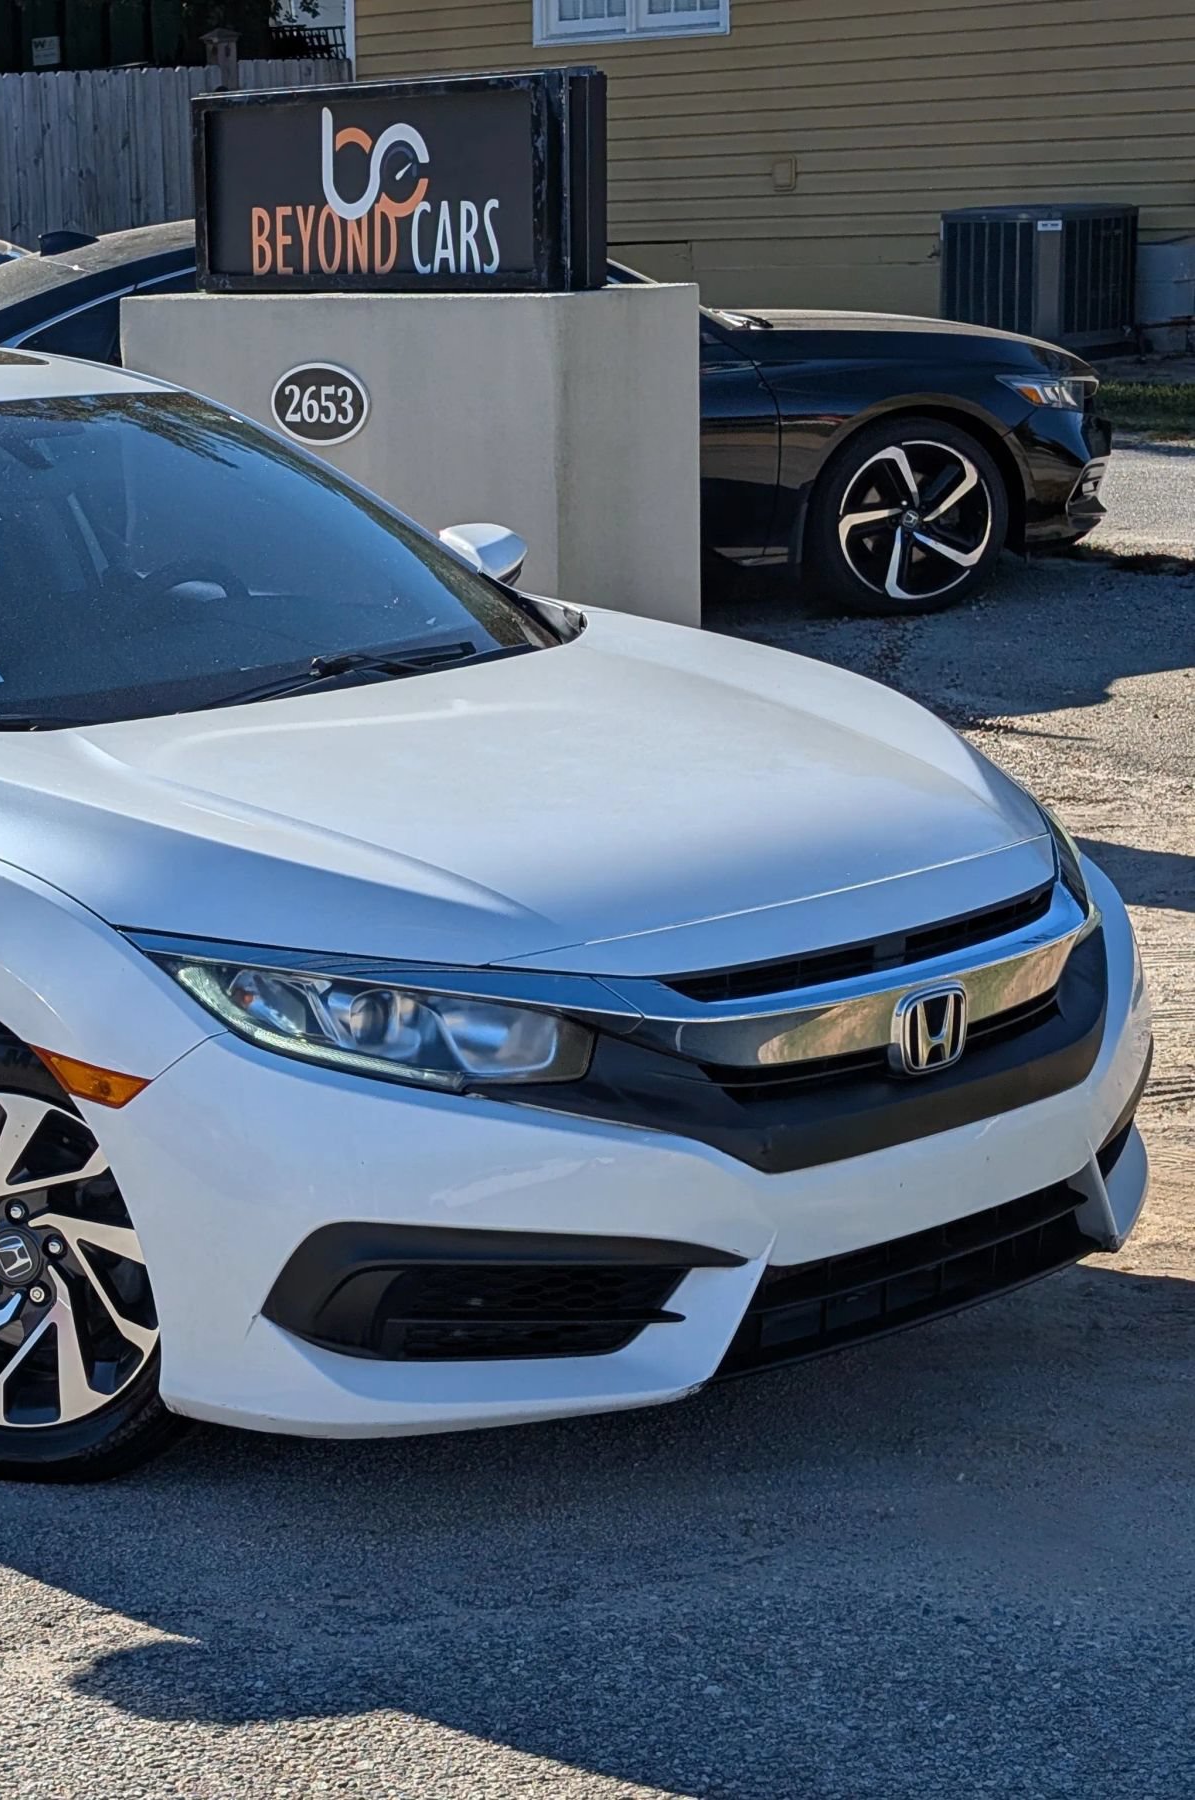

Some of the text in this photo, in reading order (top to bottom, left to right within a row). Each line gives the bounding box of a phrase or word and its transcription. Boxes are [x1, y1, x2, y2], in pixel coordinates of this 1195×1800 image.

[251, 199, 500, 275] BEYOND CARS
[284, 385, 354, 424] 2653
